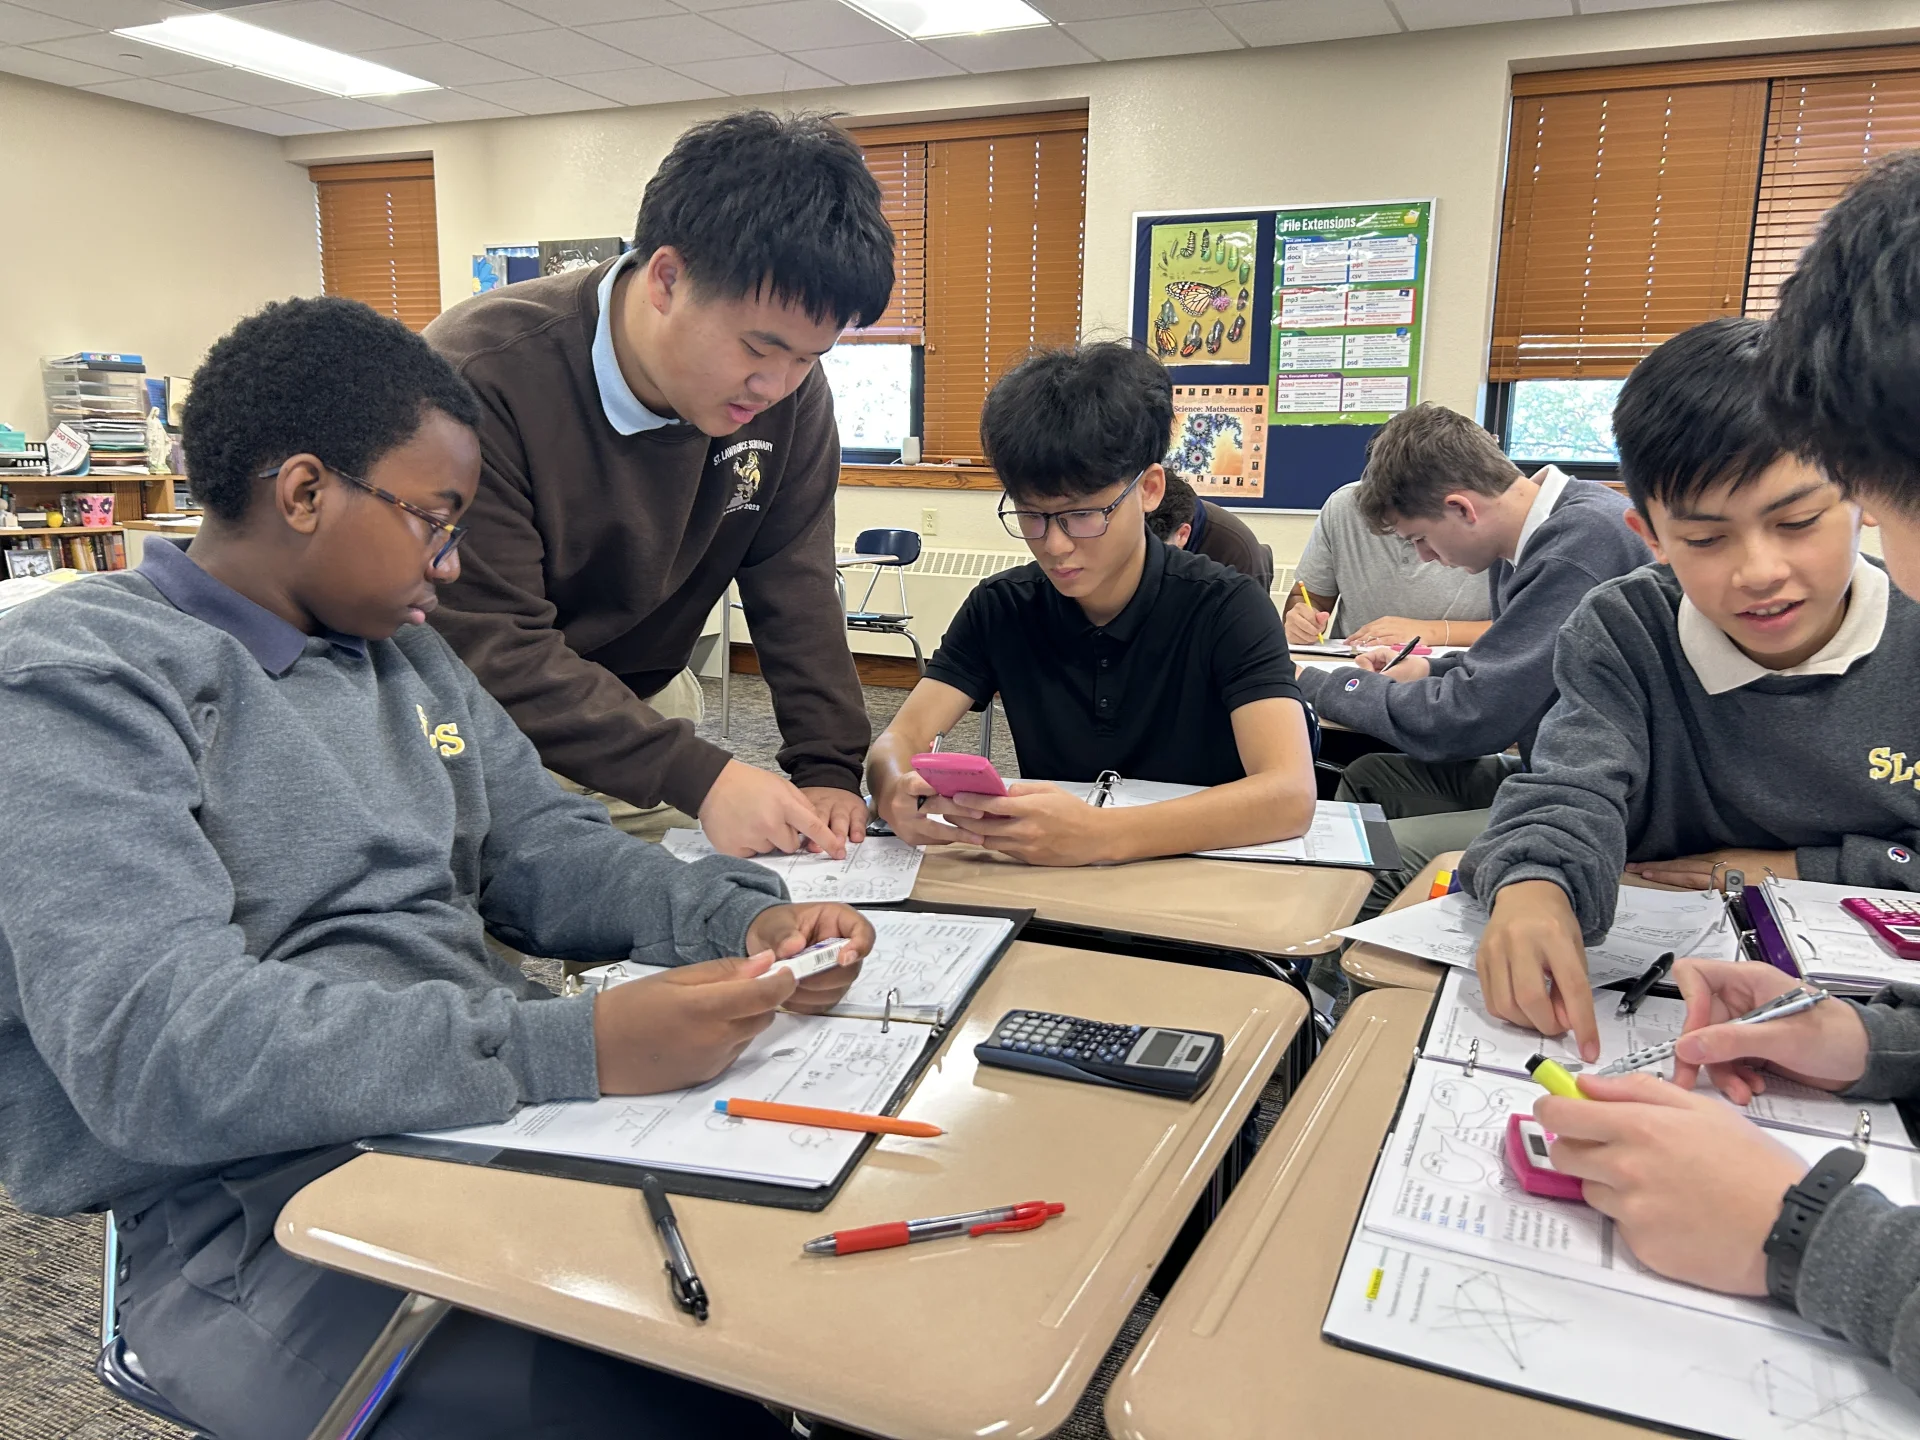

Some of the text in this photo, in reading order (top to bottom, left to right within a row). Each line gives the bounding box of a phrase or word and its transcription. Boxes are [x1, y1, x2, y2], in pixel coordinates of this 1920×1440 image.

[1282, 216, 1356, 232] File Extensions
[721, 441, 748, 460] LAWRENCE
[748, 439, 773, 452] SEMINARY
[1868, 746, 1920, 791] SL
